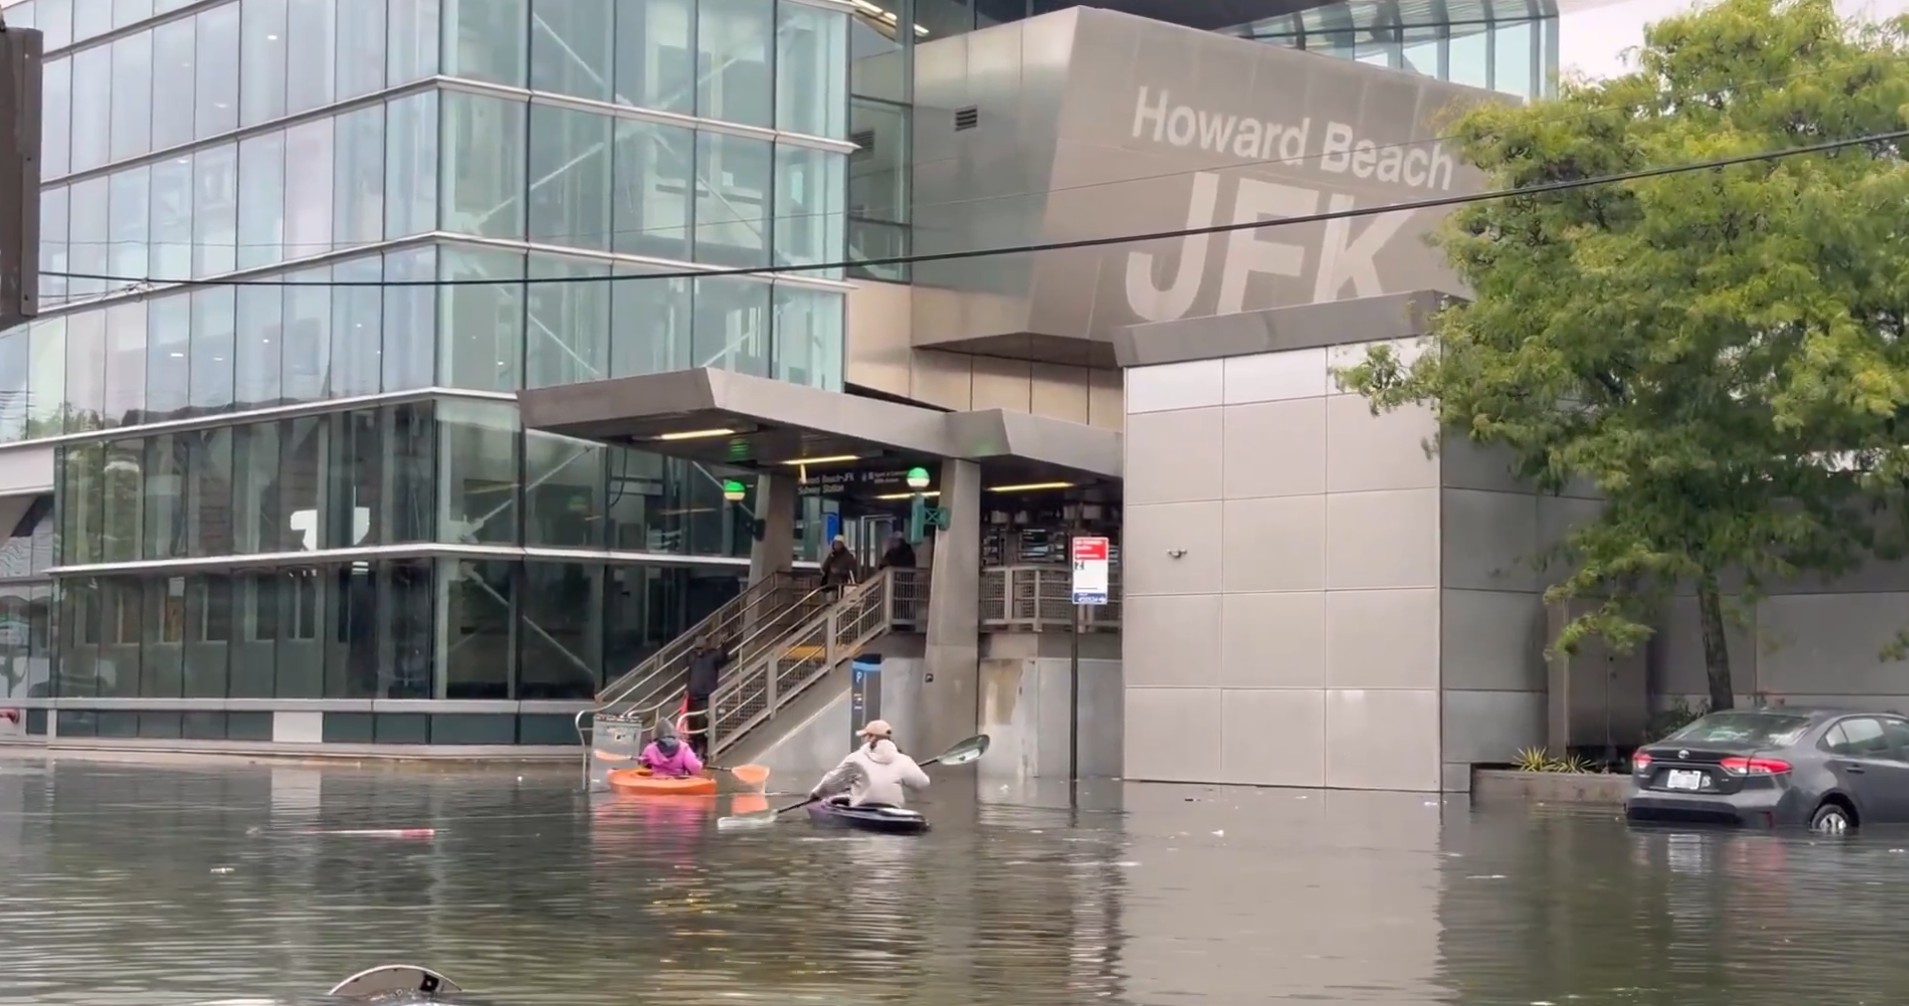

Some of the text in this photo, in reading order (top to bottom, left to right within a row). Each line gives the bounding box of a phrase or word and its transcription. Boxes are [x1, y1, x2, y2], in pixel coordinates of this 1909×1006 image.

[1132, 85, 1454, 191] Howard Beach
[1125, 171, 1416, 322] JFK
